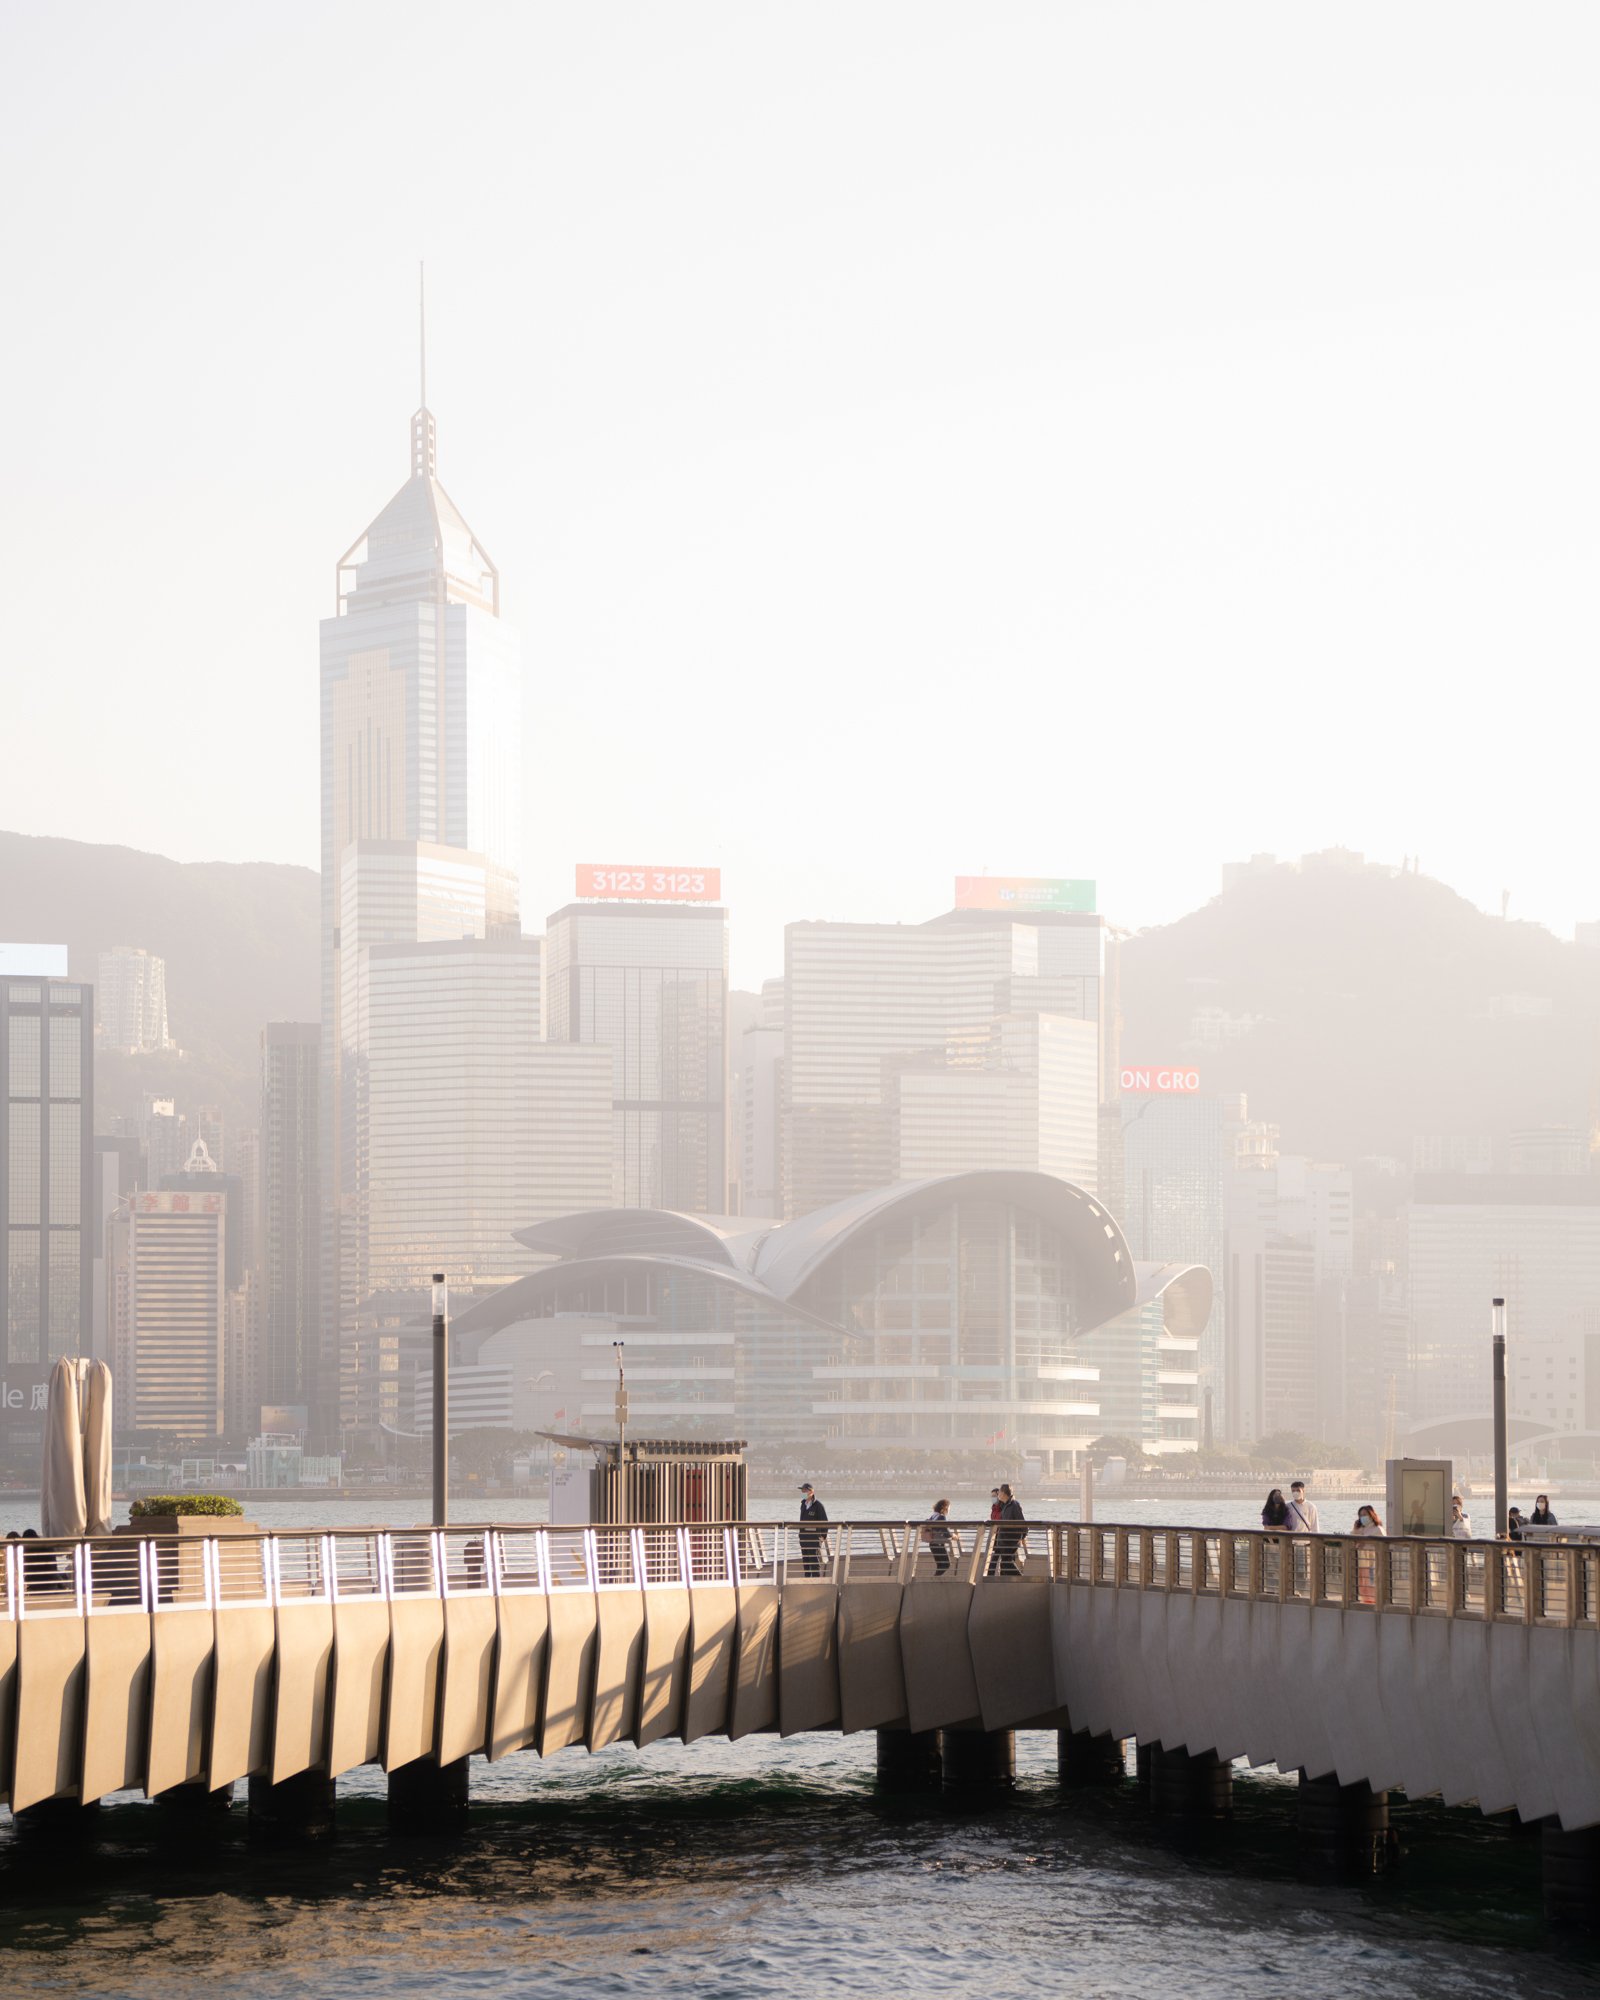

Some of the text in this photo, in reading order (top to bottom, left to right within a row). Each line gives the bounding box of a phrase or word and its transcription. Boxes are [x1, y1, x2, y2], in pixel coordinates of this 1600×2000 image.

[592, 871, 705, 893] 3123 3123
[1120, 1070, 1200, 1090] ON GRO
